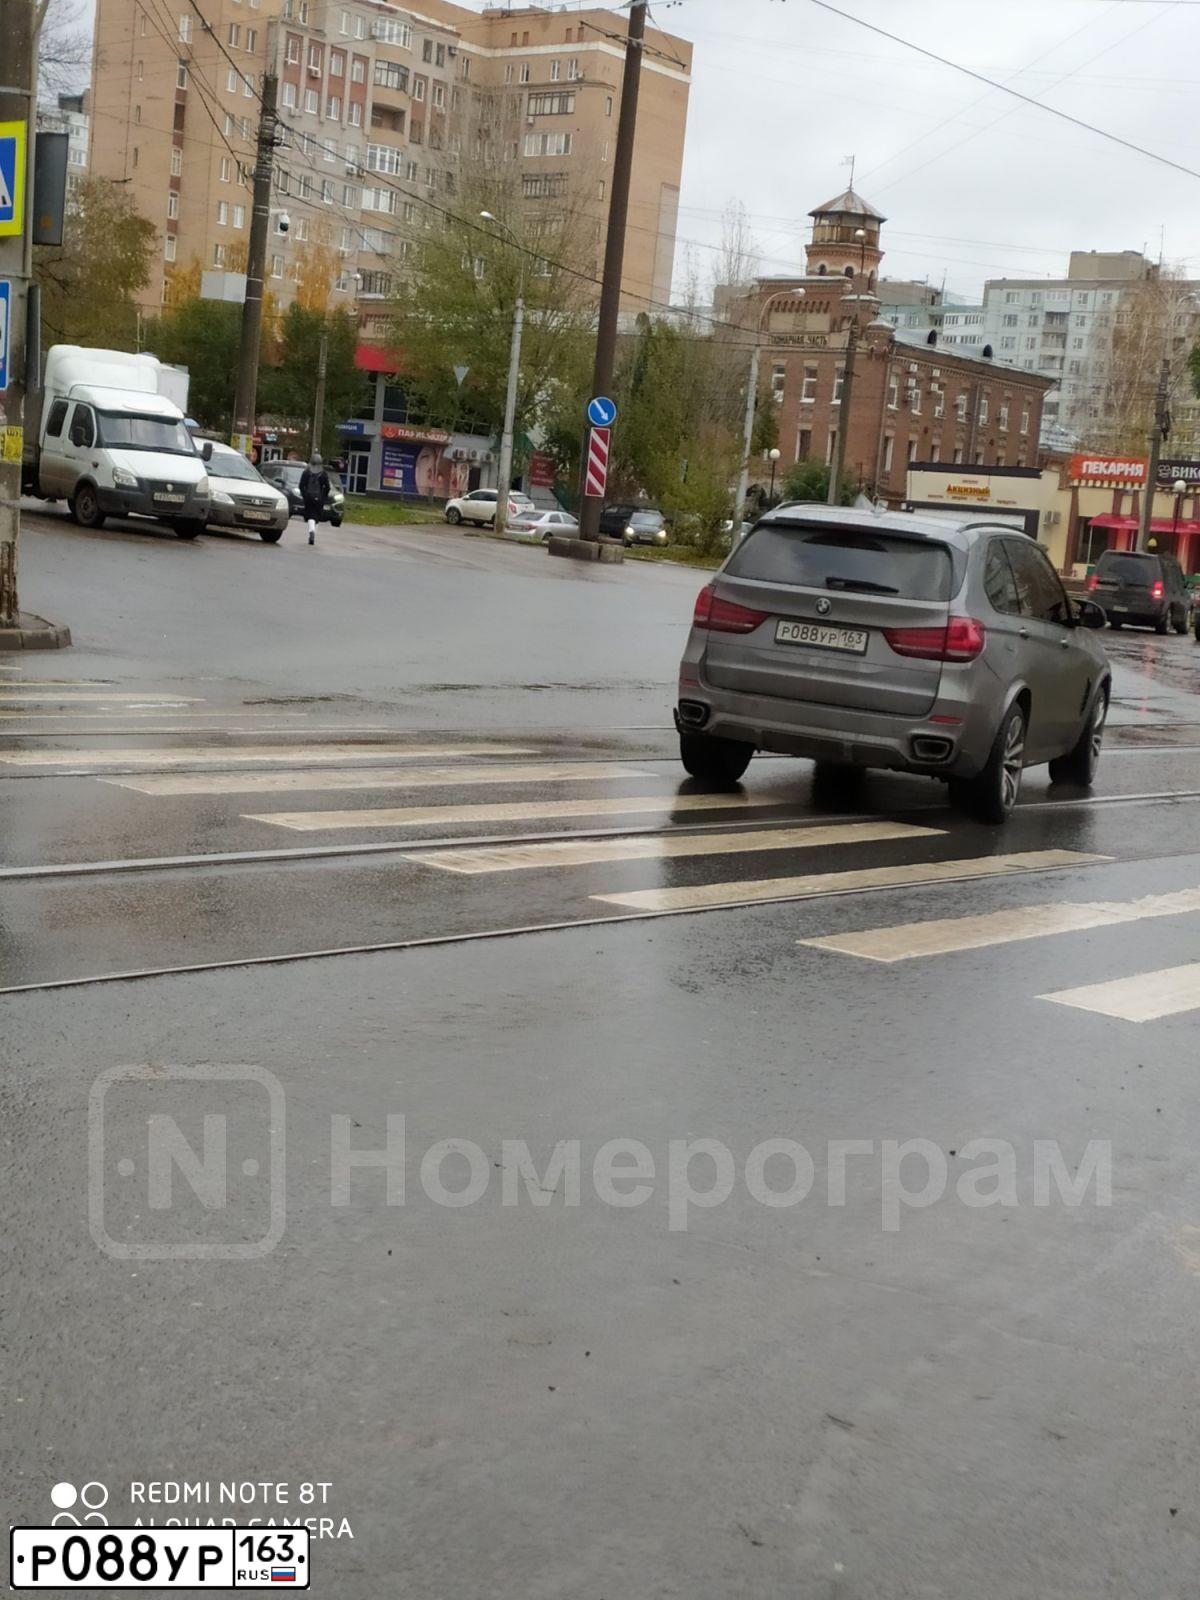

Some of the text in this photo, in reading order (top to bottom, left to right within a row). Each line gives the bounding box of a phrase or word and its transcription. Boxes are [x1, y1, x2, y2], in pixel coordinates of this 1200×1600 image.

[1082, 461, 1144, 477] ПЕКАРНЯ
[1171, 466, 1200, 479] БИК
[841, 631, 862, 644] 163
